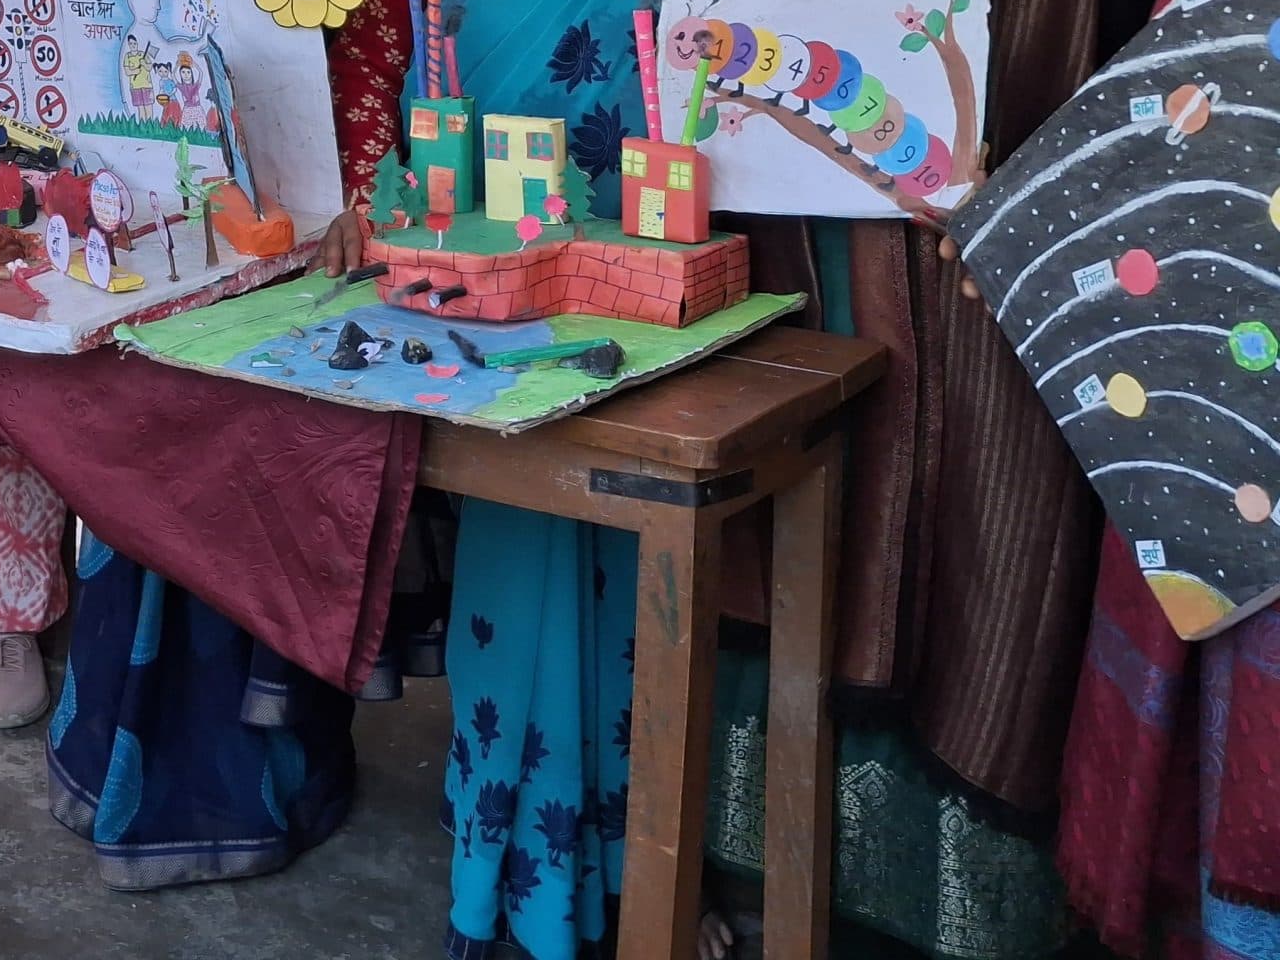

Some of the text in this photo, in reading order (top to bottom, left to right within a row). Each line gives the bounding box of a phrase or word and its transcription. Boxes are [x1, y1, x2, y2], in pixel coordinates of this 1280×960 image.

[67, 0, 116, 19] बाल श्रम
[36, 45, 56, 63] 50
[712, 39, 940, 189] 1 2 3 4 5 6 7 8 9 10
